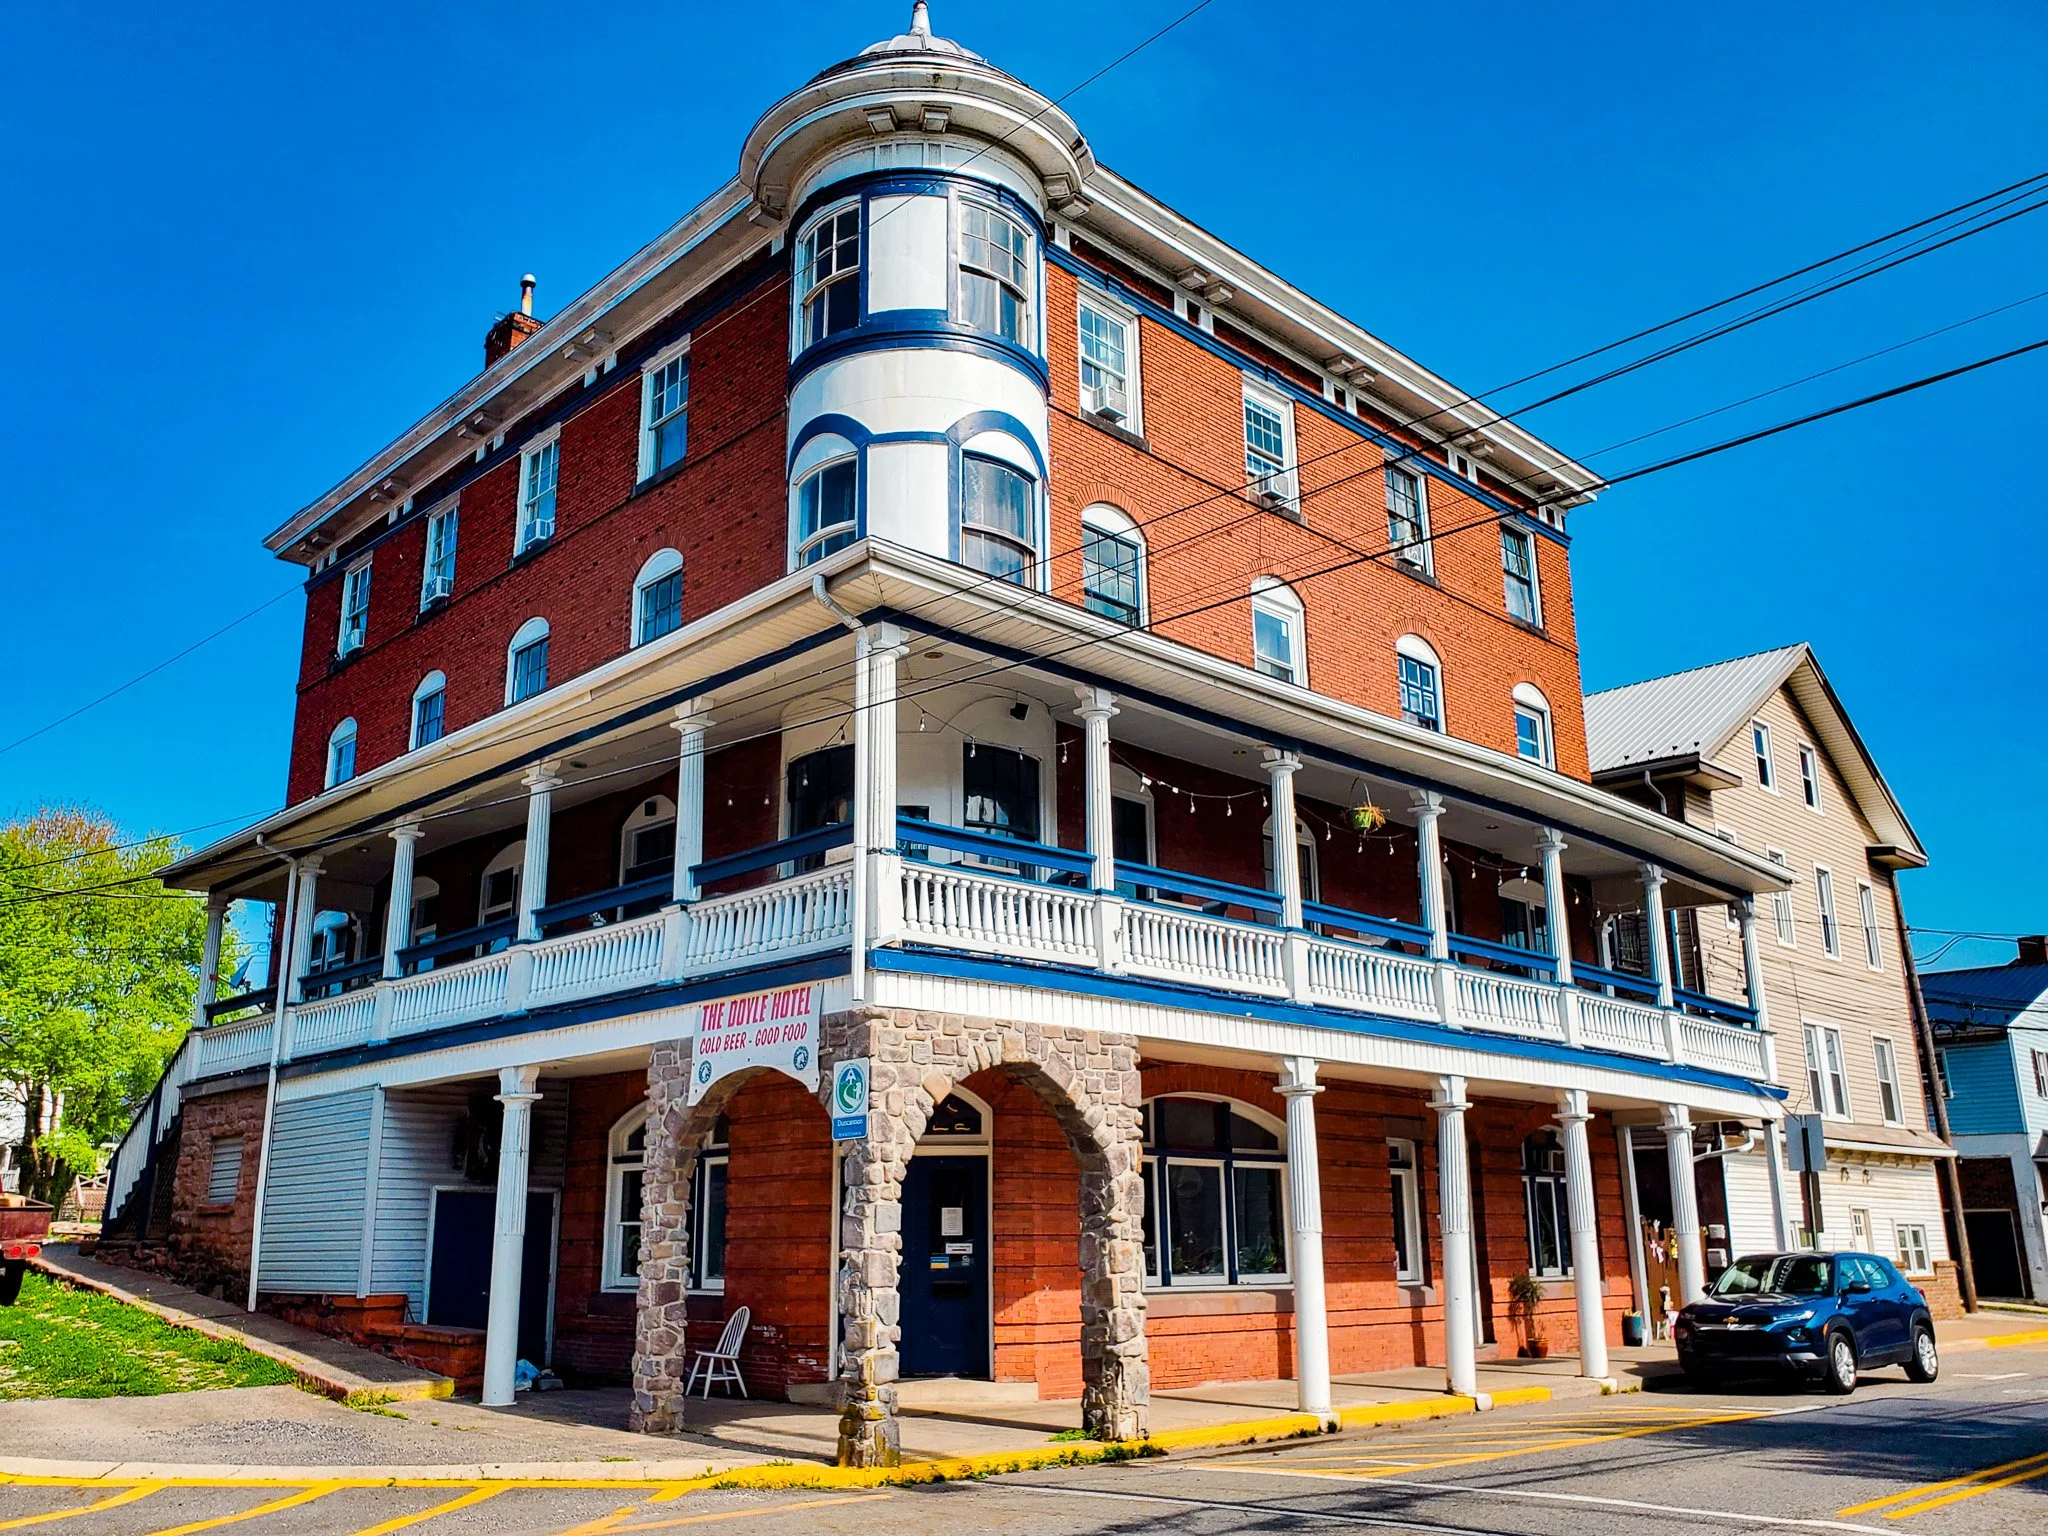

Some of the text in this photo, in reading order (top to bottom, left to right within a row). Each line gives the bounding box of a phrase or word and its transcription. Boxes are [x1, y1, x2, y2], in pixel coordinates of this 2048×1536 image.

[702, 986, 811, 1031] THE DOYLE HOTEL
[699, 1036, 721, 1055] COLD
[723, 1031, 747, 1051] BEER
[755, 1026, 780, 1047] GOOD
[782, 1021, 807, 1042] FOOD
